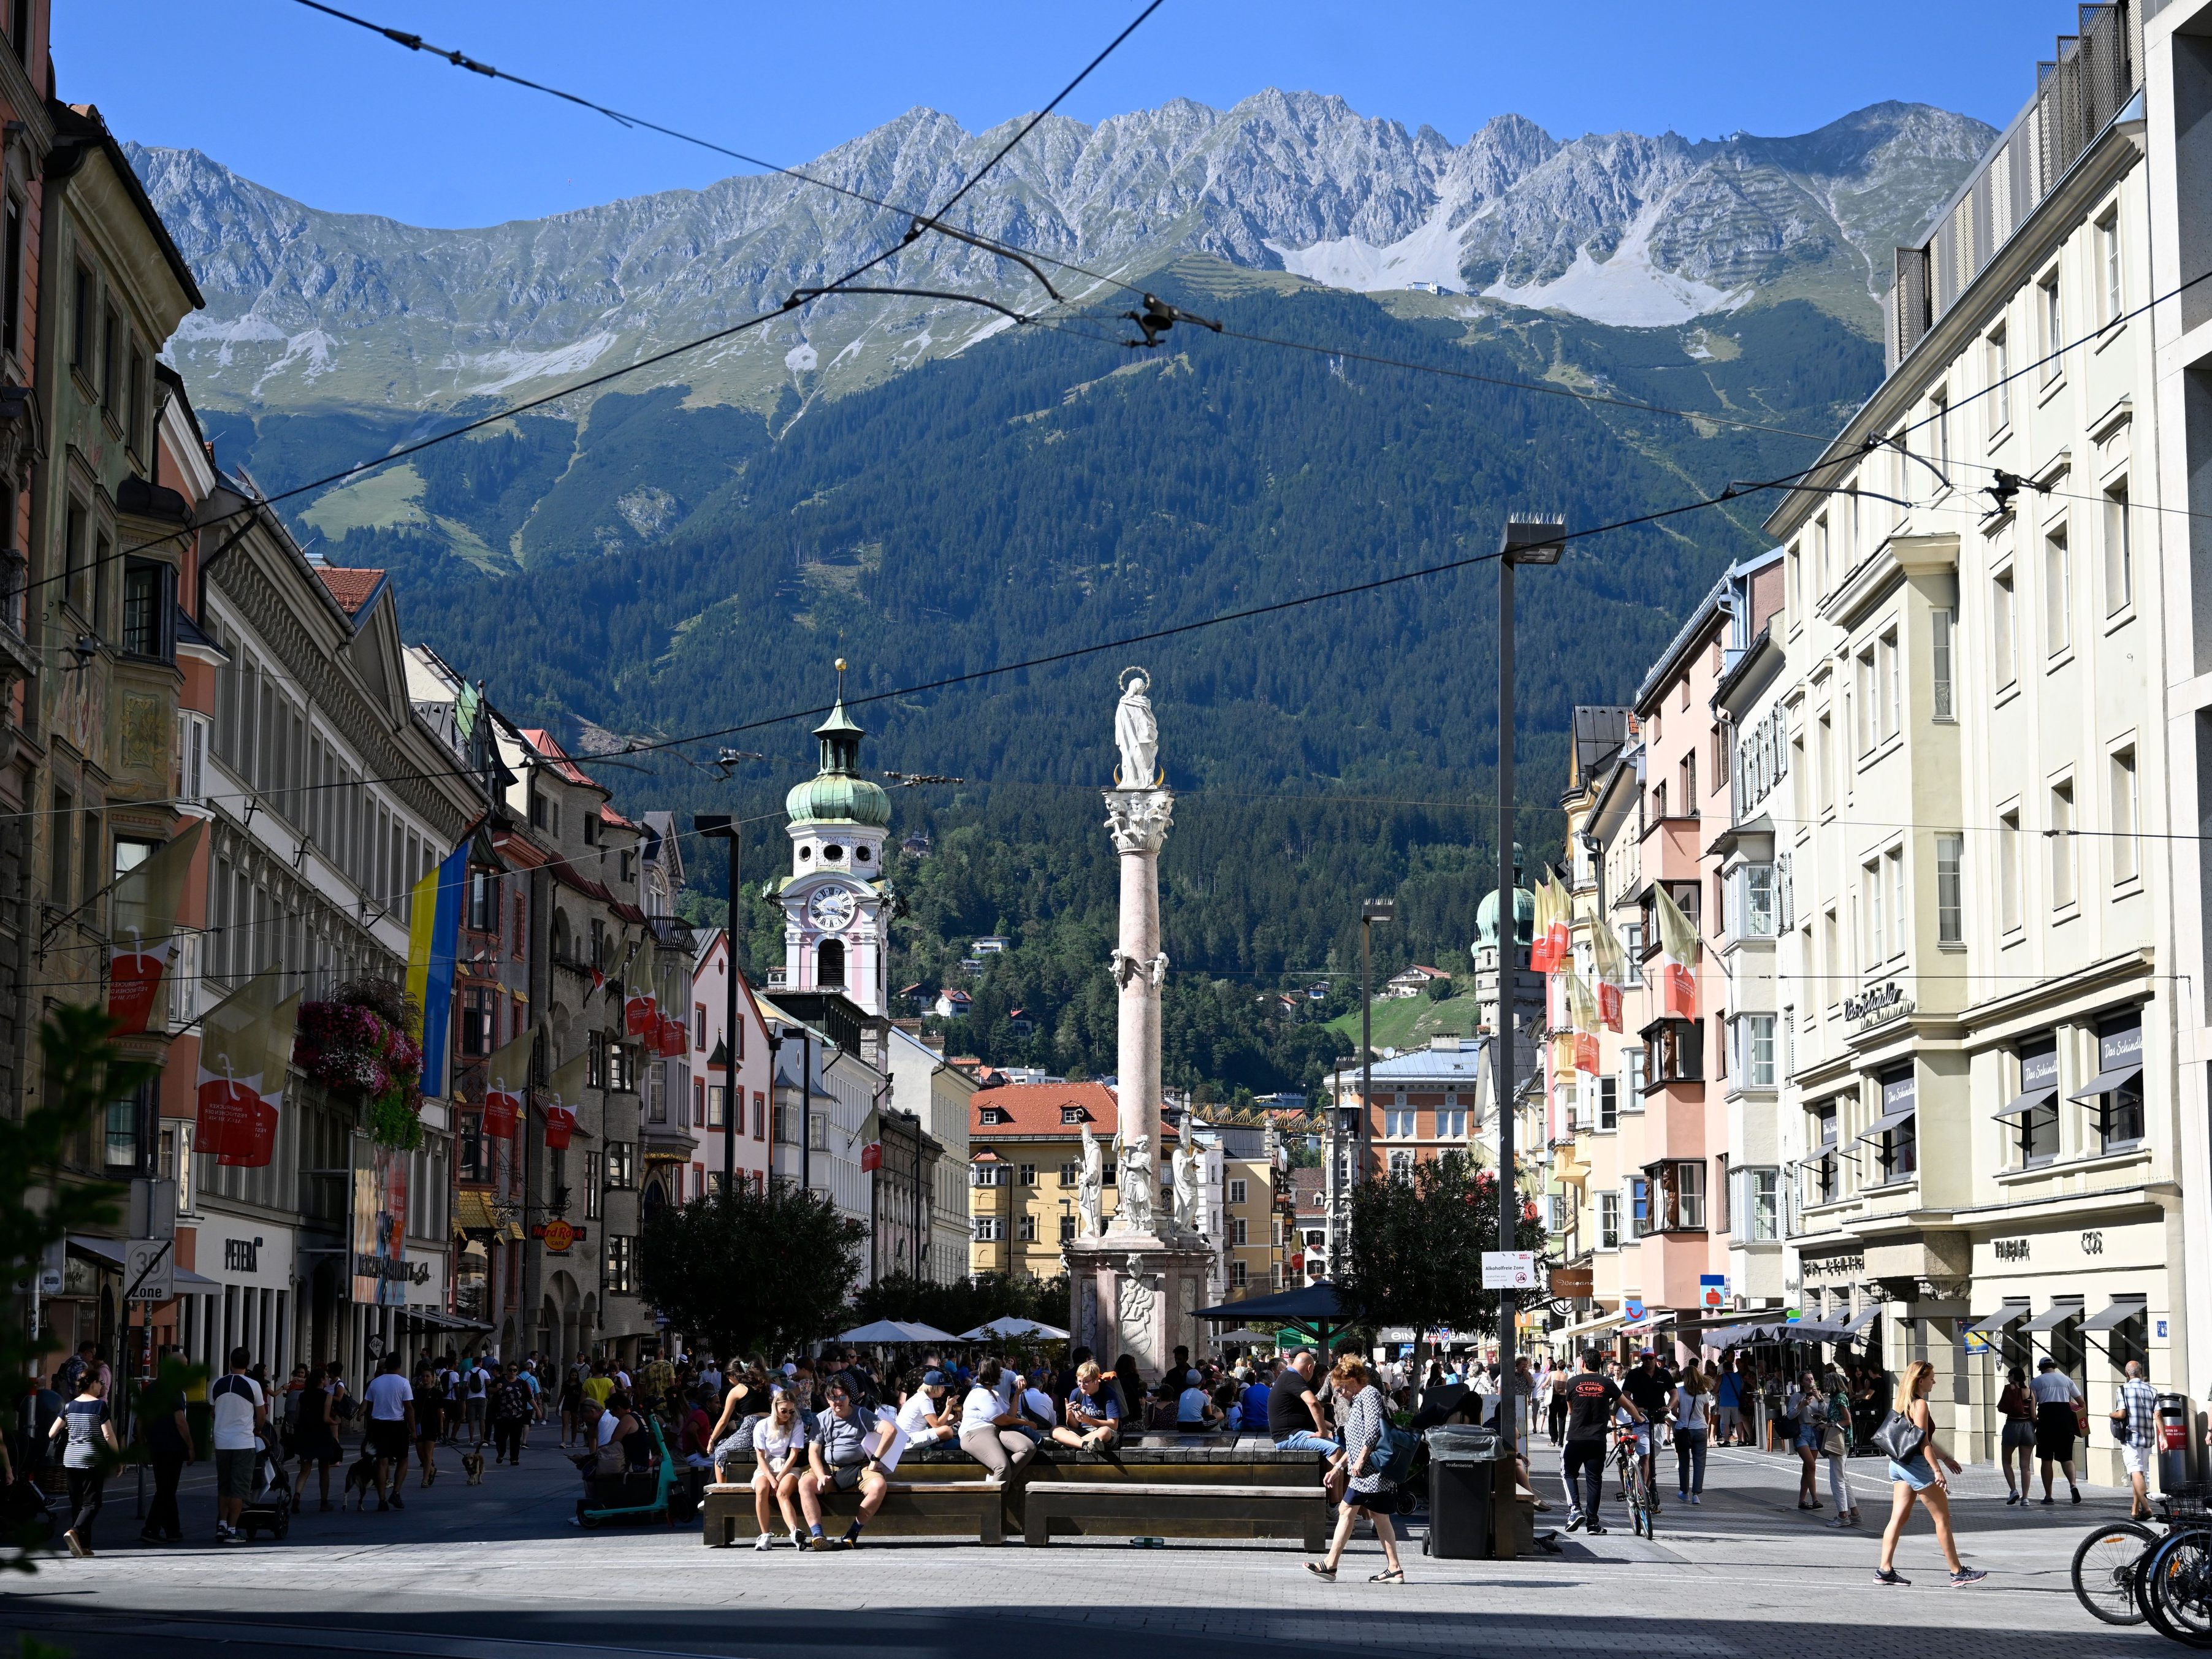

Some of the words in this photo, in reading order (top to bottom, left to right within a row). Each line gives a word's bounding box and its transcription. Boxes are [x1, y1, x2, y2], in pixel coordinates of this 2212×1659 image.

[1843, 998, 1860, 1021] Das
[1859, 982, 1903, 1018] Schindler
[2105, 1043, 2115, 1058] Das
[2026, 1067, 2035, 1081] Das
[532, 1226, 559, 1237] Hard
[559, 1227, 584, 1240] Rock
[2081, 1232, 2102, 1252] COS
[226, 1238, 257, 1272] PETERA
[1994, 1240, 2030, 1258] TABAK
[136, 1252, 159, 1274] 30
[131, 1287, 162, 1298] Zone
